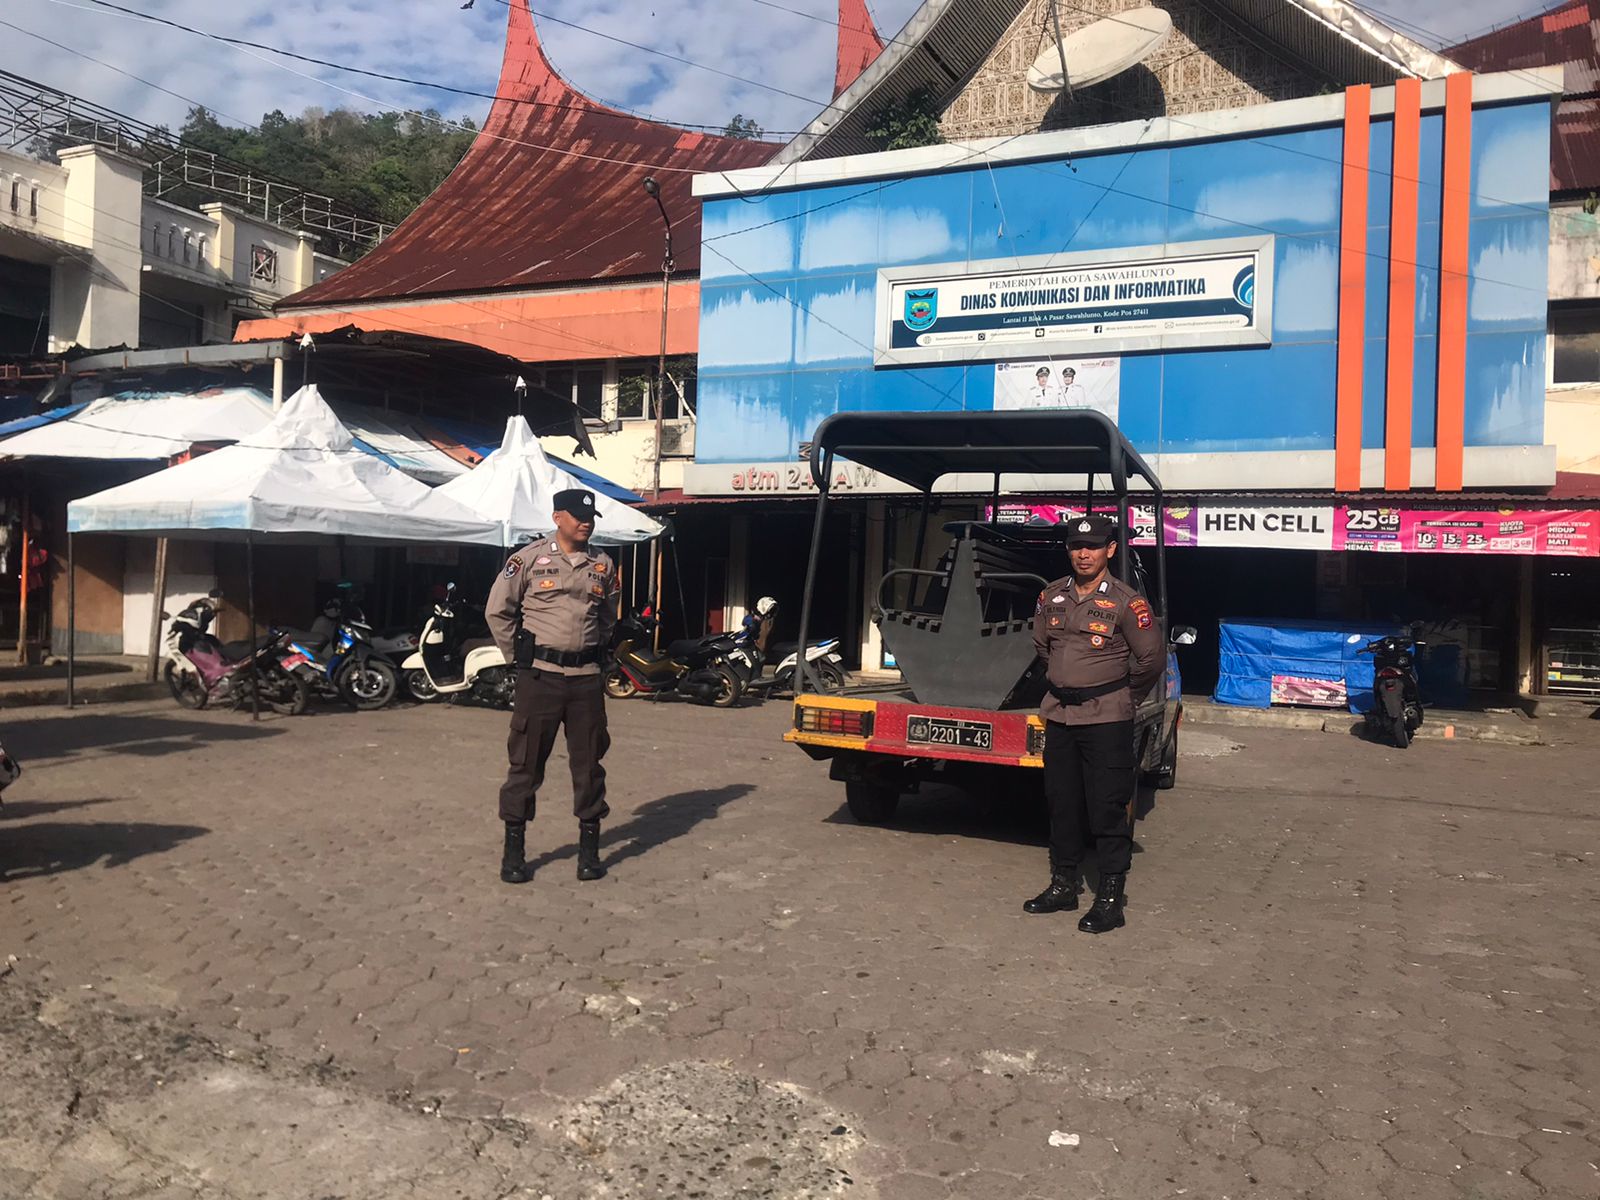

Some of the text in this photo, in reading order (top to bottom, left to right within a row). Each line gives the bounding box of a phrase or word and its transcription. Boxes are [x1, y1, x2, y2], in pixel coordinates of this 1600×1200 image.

[989, 267, 1175, 290] PEMERINTAH KOTA SAWAHLUNTO
[960, 277, 1206, 311] DINAS KOMUNIKASI DAN INFORMATIKA
[1049, 313, 1065, 322] Pasar
[1103, 310, 1120, 318] Kode
[1121, 309, 1132, 317] Pos
[731, 467, 779, 490] atm
[1205, 513, 1325, 533] HEN CELL
[1346, 510, 1399, 529] 25 GB
[1087, 608, 1116, 622] POLRI
[931, 726, 960, 744] 2201
[973, 731, 989, 748] 43
